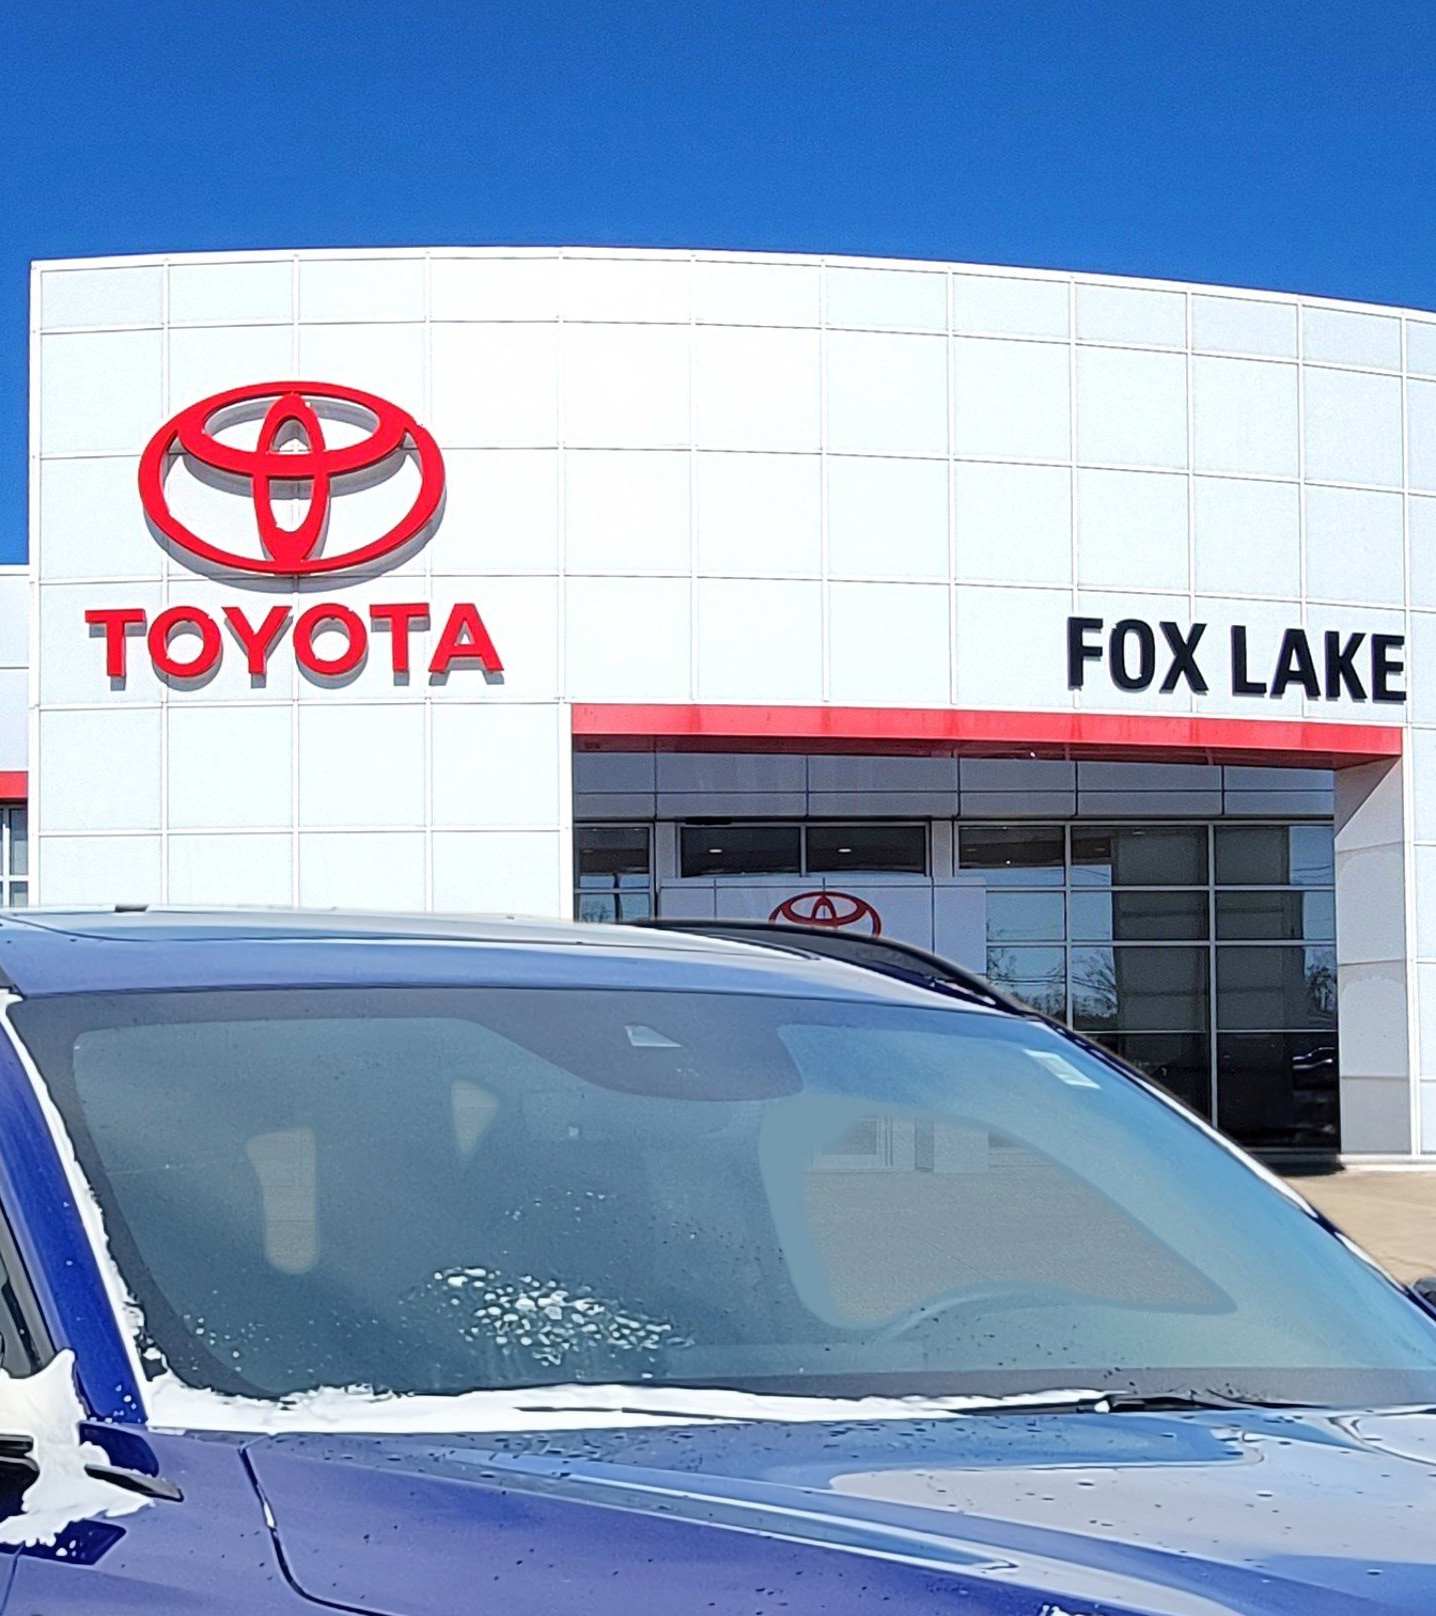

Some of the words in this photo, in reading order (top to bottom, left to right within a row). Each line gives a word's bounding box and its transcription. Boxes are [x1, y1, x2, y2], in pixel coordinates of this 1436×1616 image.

[84, 602, 504, 680] TOYOTA
[1067, 616, 1209, 692] FOX
[1230, 624, 1407, 702] LAKE
